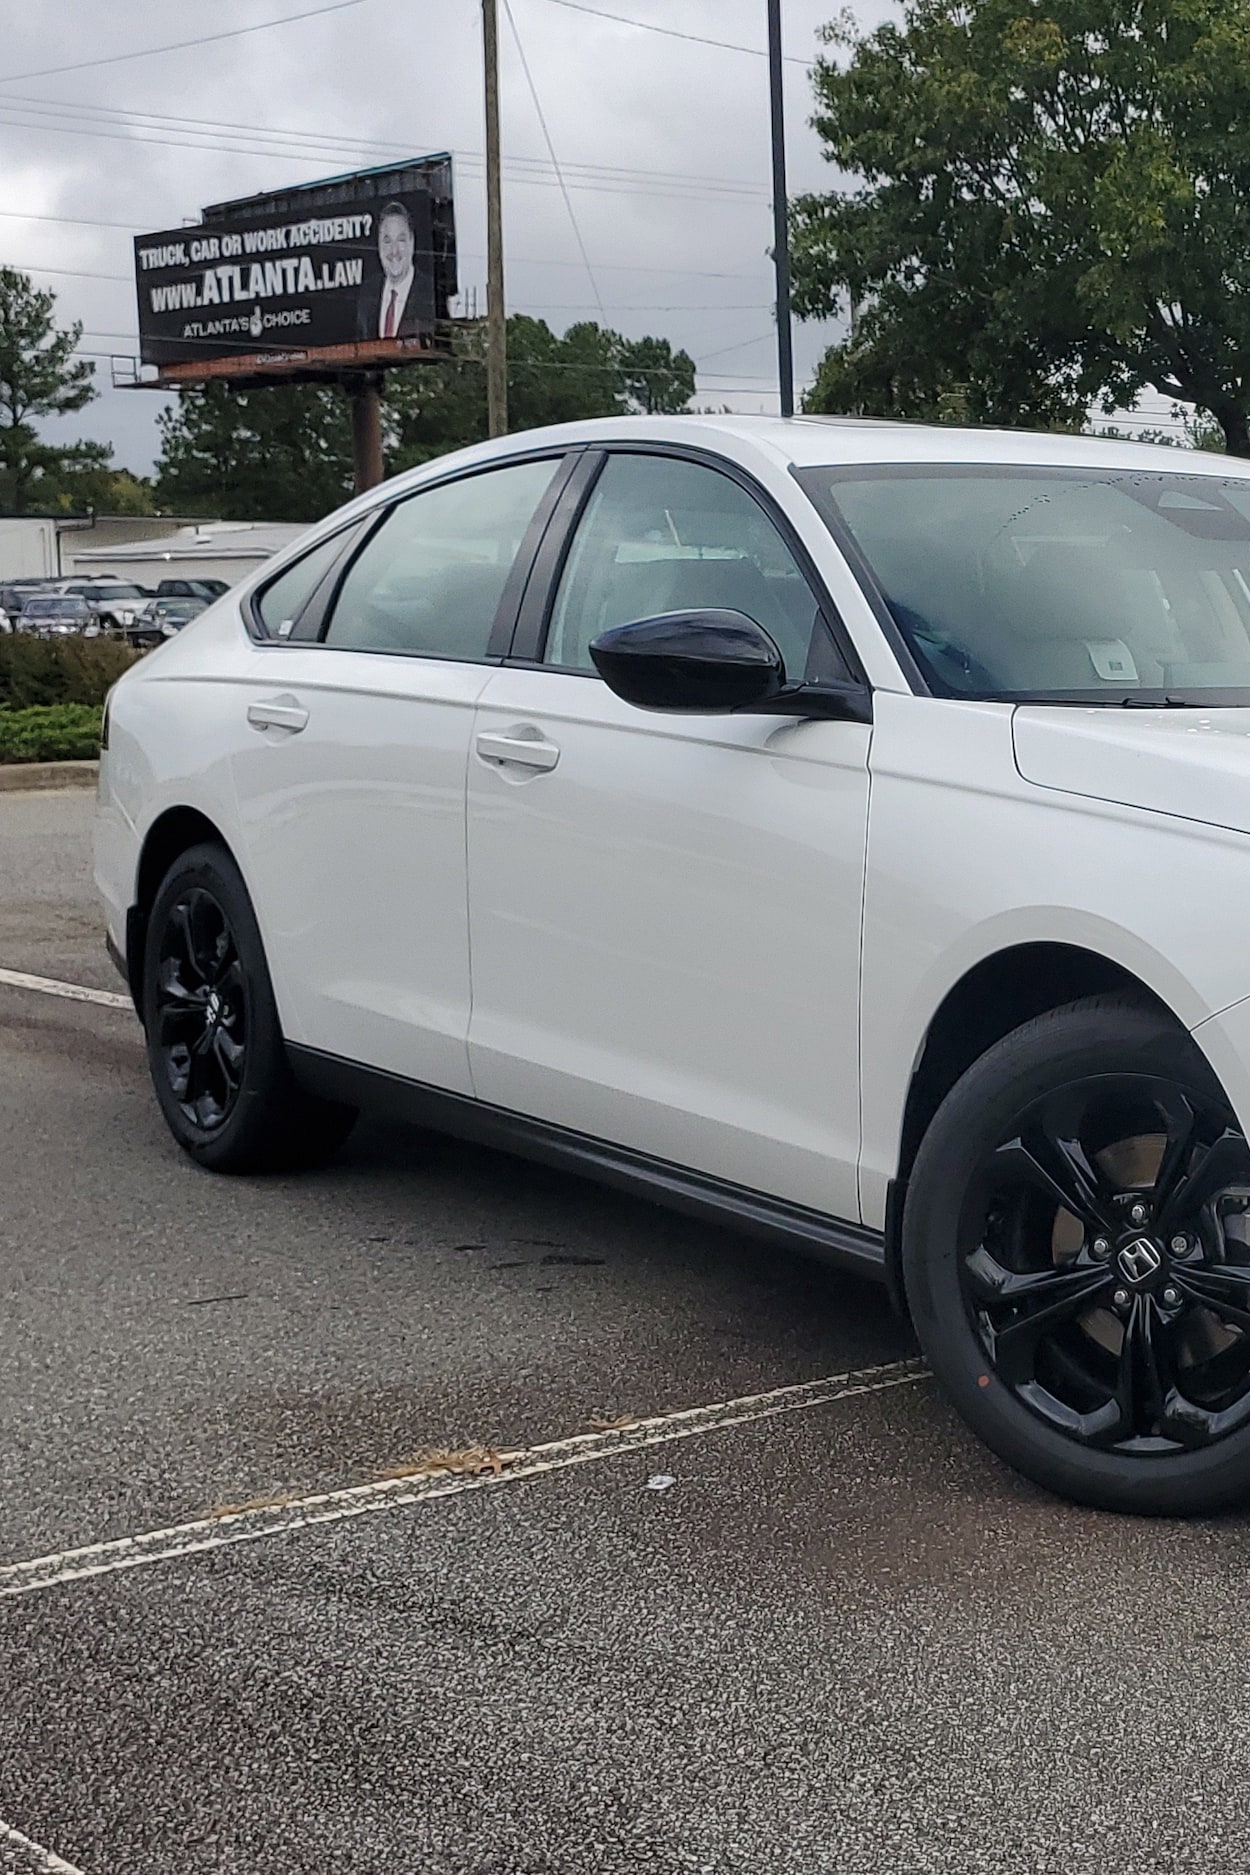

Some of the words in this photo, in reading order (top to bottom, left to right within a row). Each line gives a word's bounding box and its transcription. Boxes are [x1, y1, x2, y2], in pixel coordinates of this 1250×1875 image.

[139, 242, 190, 270] TRUCK,
[190, 238, 220, 262] CAR
[221, 234, 242, 258] OR
[243, 228, 287, 254] WORK
[288, 214, 373, 248] ACCIDENT?
[183, 316, 250, 338] ATLANTA'S
[263, 308, 311, 328] CHOICE
